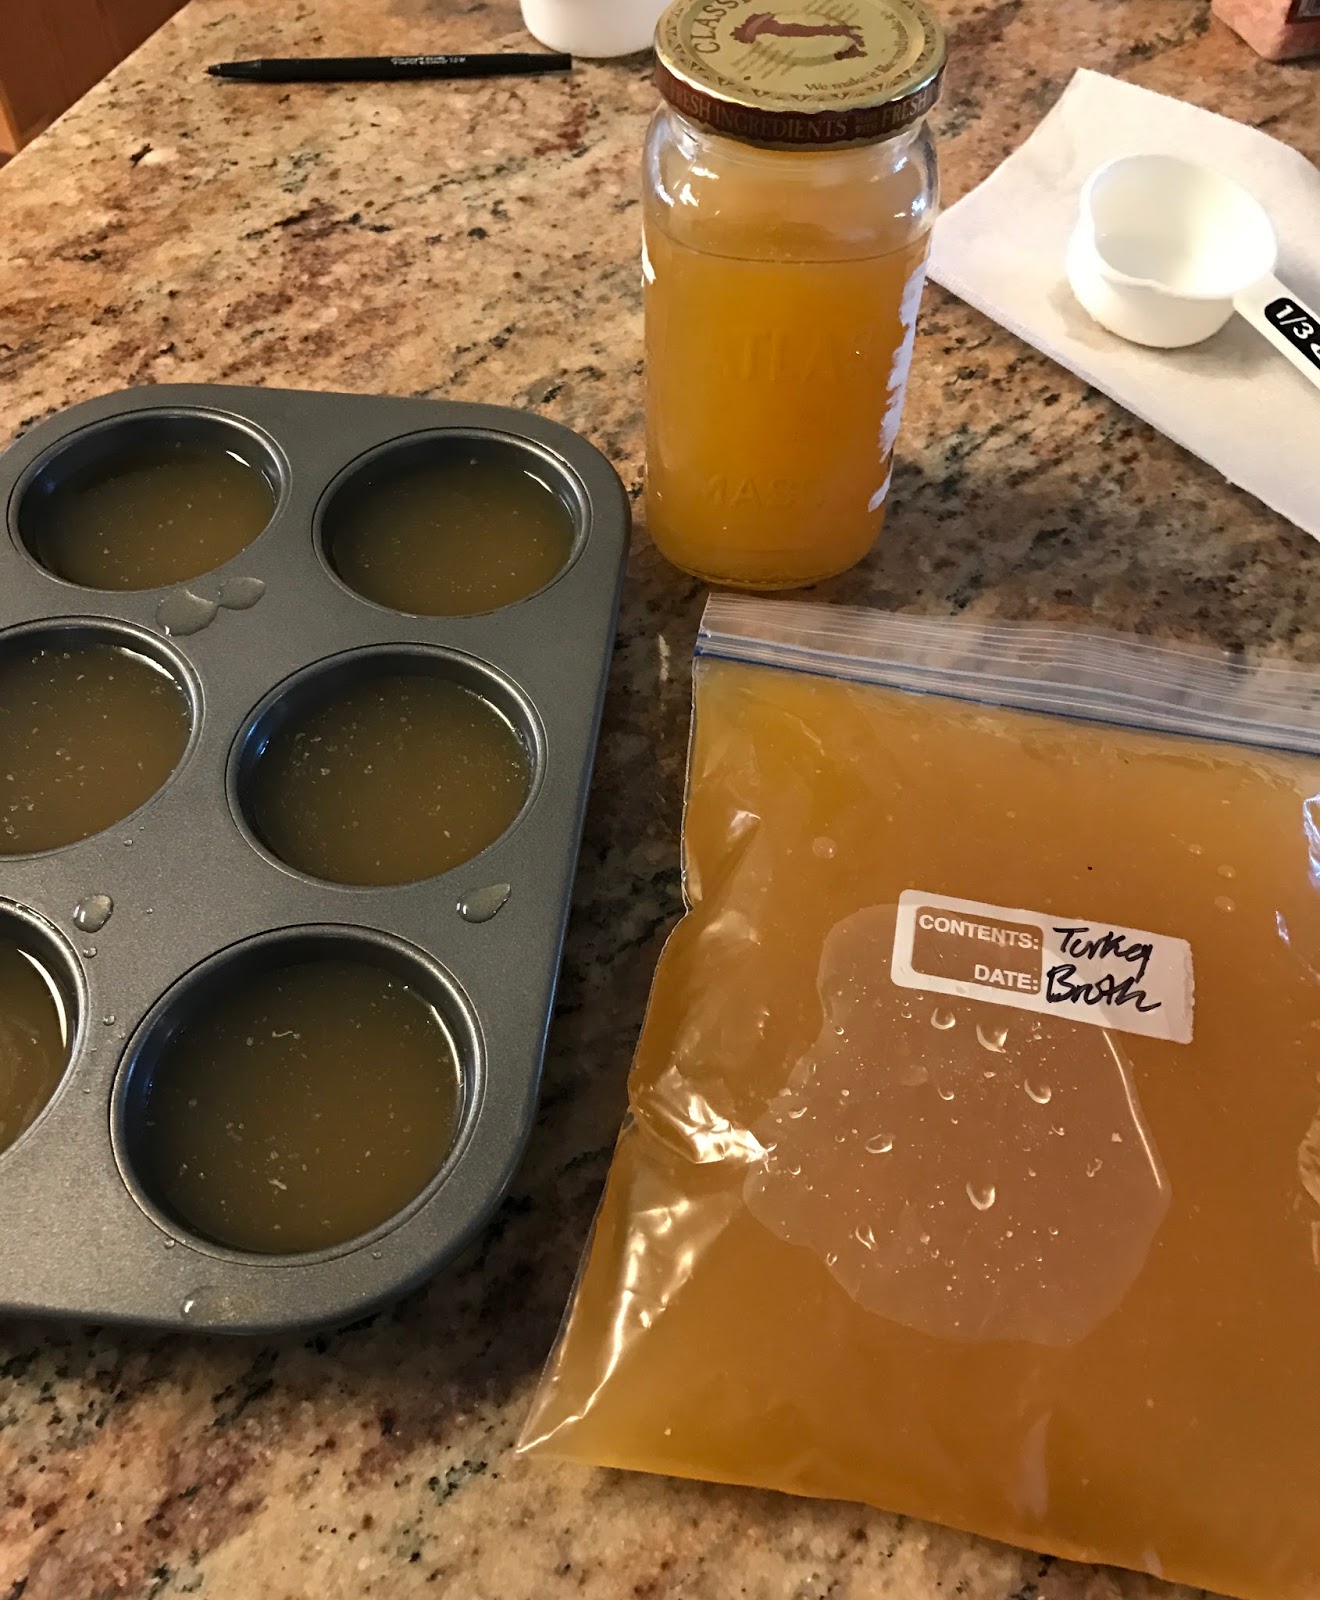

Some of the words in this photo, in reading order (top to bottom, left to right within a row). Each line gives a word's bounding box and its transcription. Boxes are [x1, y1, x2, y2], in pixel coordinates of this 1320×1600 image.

[690, 0, 751, 53] CLASS
[804, 83, 829, 91] We
[669, 80, 712, 120] FRESH
[714, 104, 848, 138] INGREDIENTS
[881, 89, 928, 128] FRESH
[1275, 304, 1315, 340] 1/3
[918, 914, 1040, 951] CONTENTS:
[973, 963, 1039, 991] DATE:
[1045, 963, 1162, 1013] Broth
